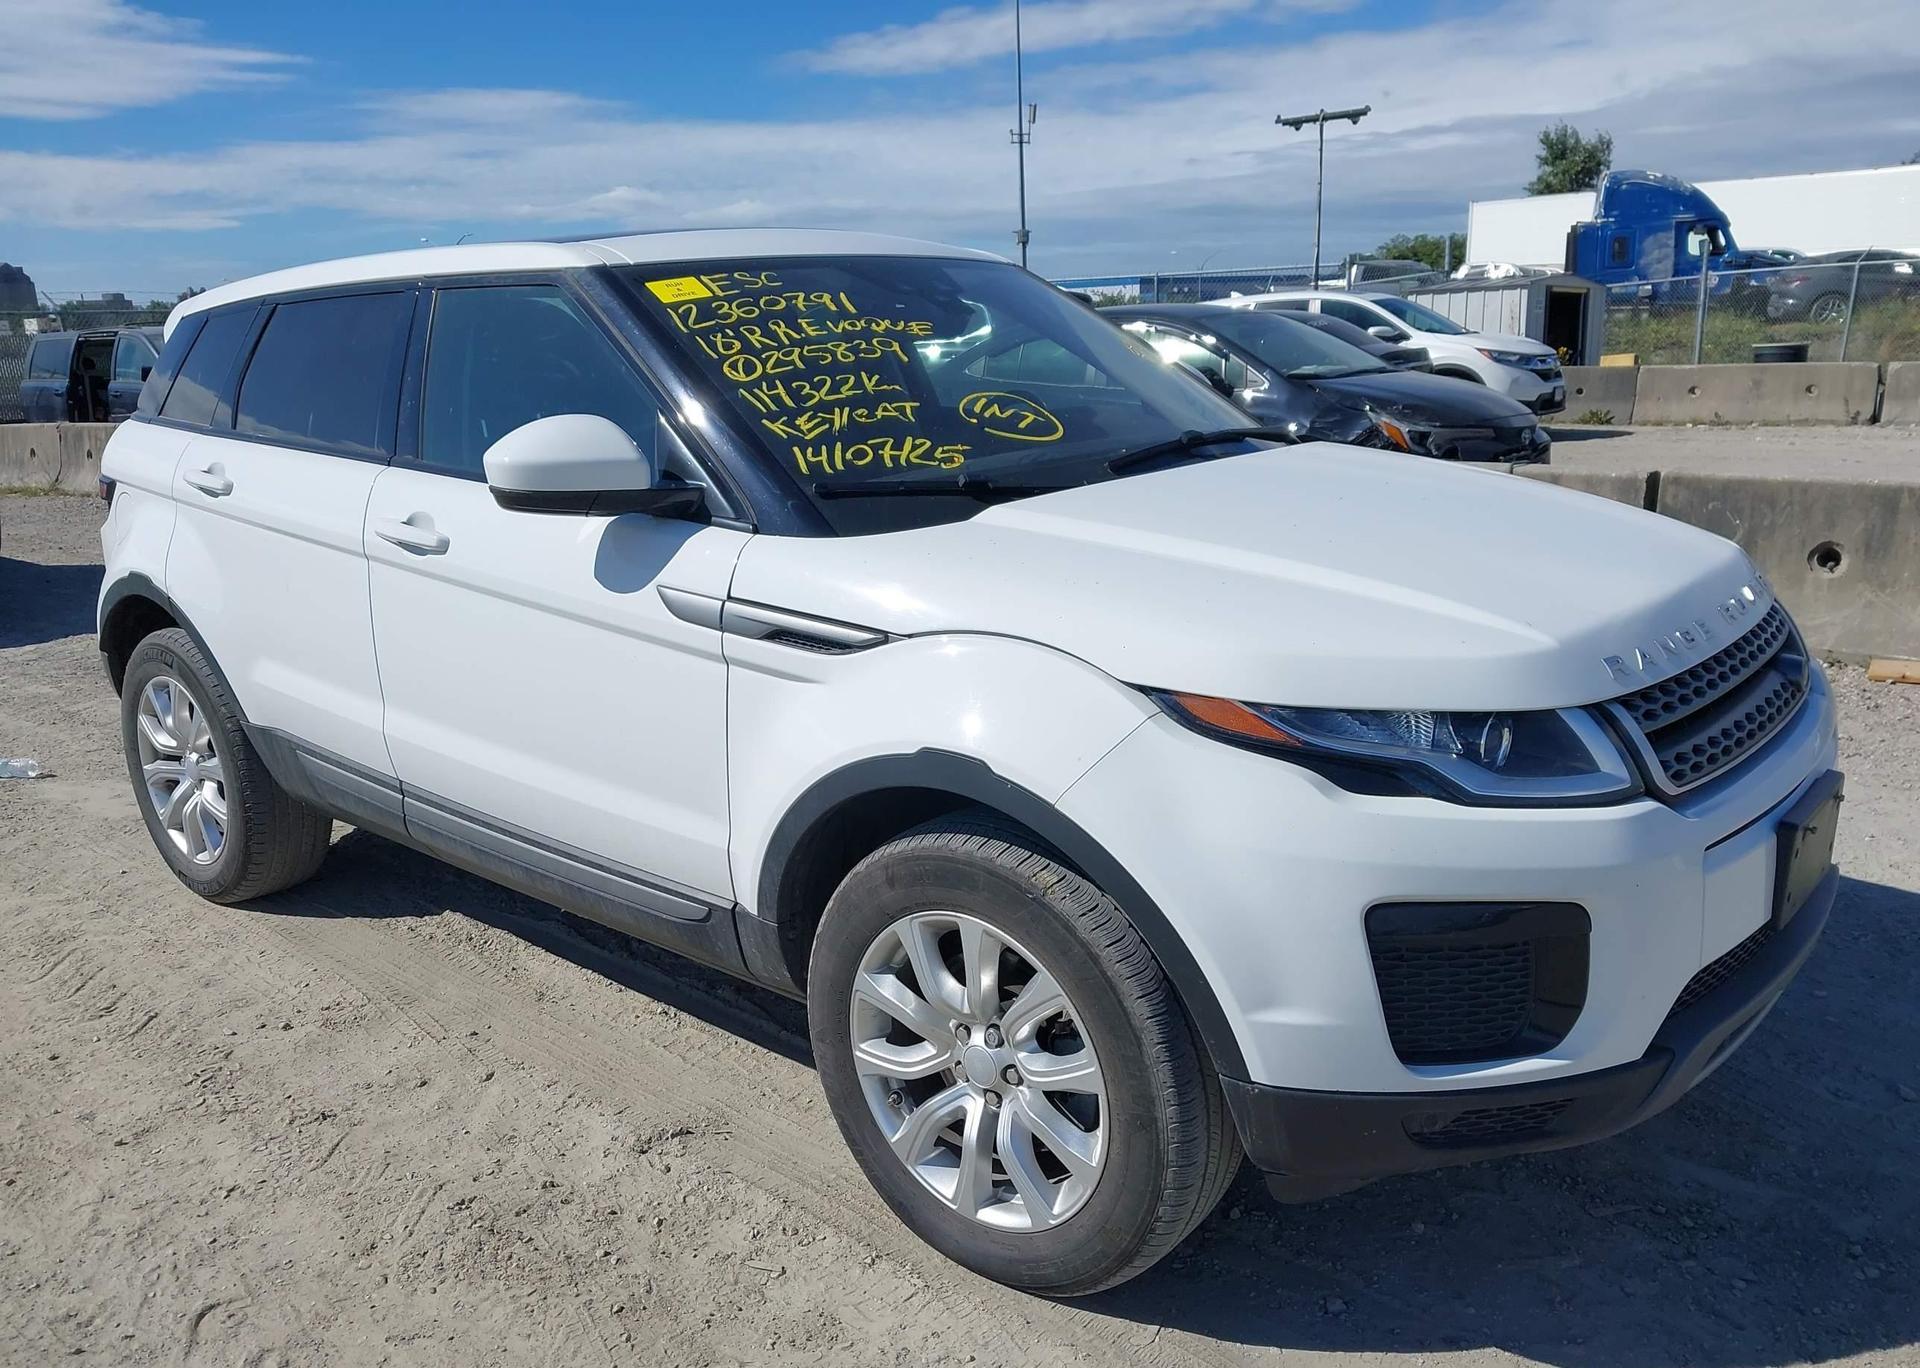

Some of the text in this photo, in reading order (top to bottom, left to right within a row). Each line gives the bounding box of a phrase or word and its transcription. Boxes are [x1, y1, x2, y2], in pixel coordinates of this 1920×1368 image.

[672, 291, 697, 299] DRIVE
[700, 271, 783, 297] ESC
[666, 291, 858, 333] 12360791
[762, 337, 909, 374] 295839
[974, 397, 1046, 429] INT
[792, 436, 973, 475] 14/07/25
[1600, 618, 1712, 680] RANGE
